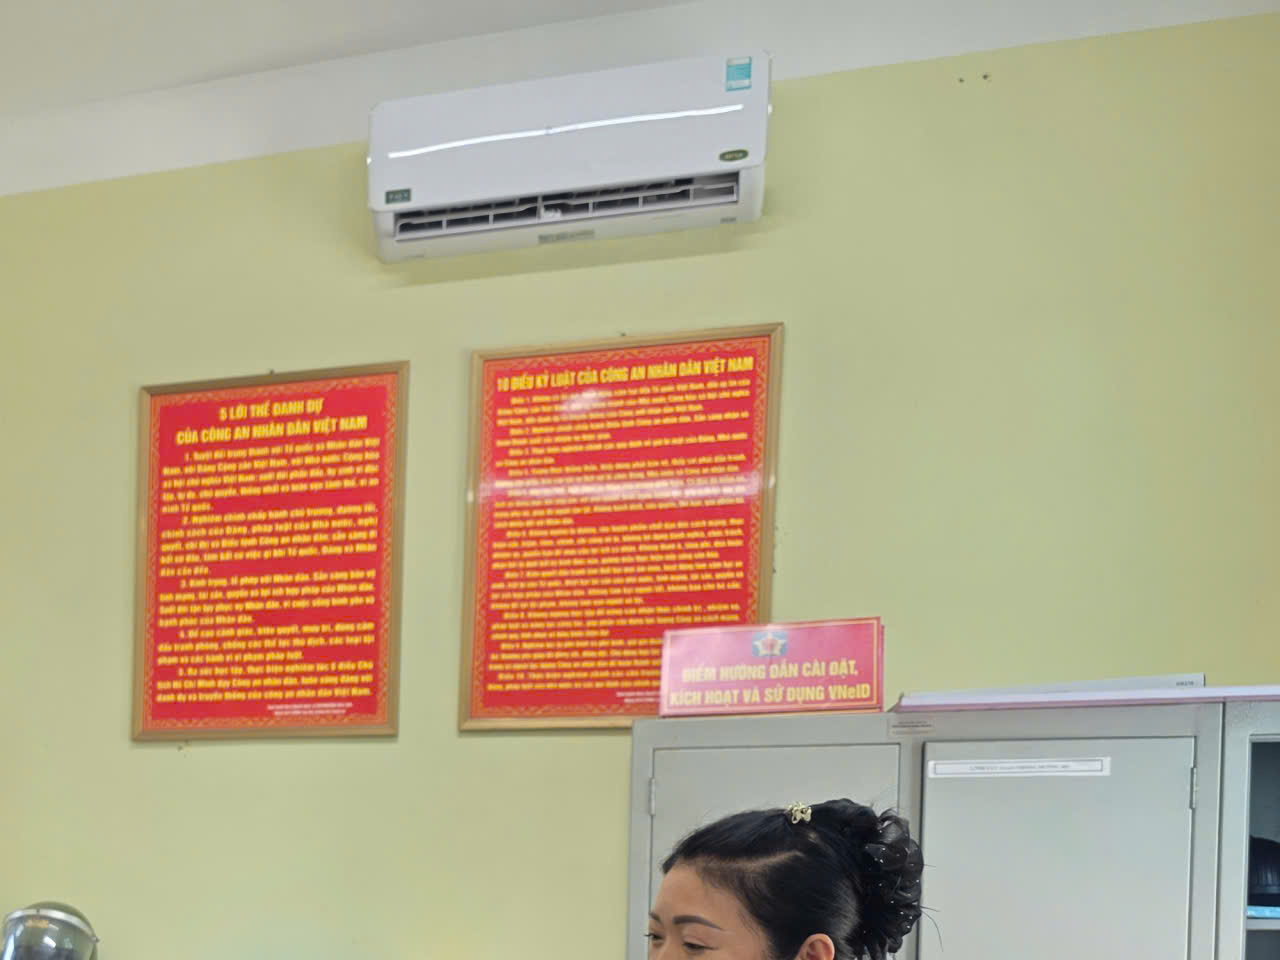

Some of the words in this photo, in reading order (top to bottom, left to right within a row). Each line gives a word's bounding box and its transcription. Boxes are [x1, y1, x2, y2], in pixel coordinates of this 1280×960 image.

[577, 366, 598, 384] CỦA
[600, 366, 628, 383] CÔNG
[631, 366, 645, 380] AN
[647, 360, 677, 379] NHÂN
[704, 357, 725, 376] VIỆT
[728, 357, 754, 371] NAM
[176, 426, 198, 445] CỦA
[201, 425, 231, 442] CÔNG
[234, 425, 250, 440] AN
[253, 422, 285, 438] NHÂN
[286, 419, 311, 435] DÂN
[313, 416, 337, 435] VIỆT
[340, 416, 368, 430] NAM
[803, 658, 825, 677] CÀI
[829, 659, 858, 679] ĐẶT,
[705, 688, 739, 707] HOẠT
[743, 685, 760, 703] VÀ
[764, 682, 784, 702] SỬ
[787, 685, 824, 704] DỤNG
[829, 683, 871, 699] VNeID
